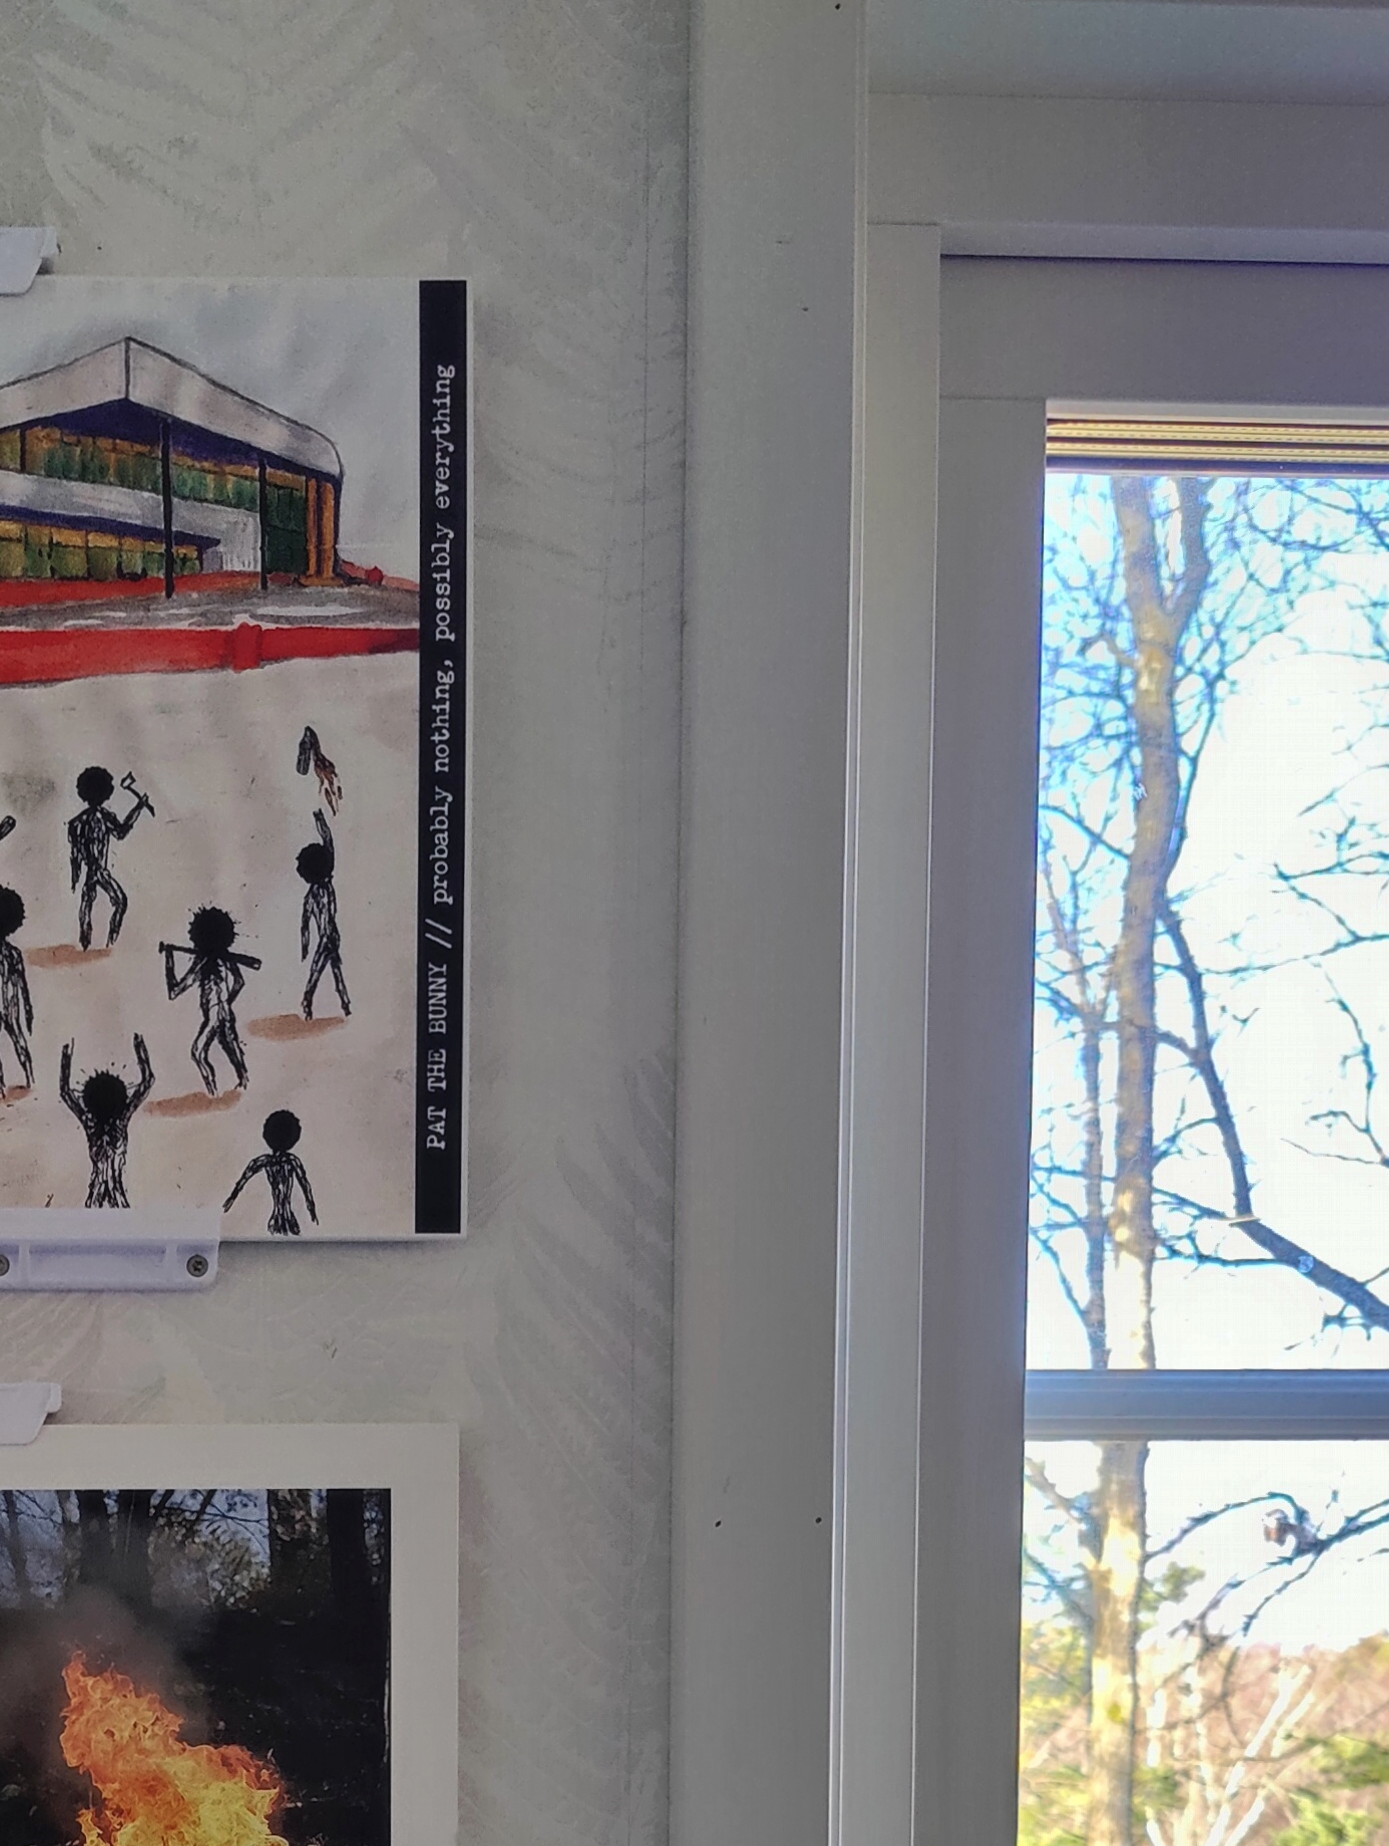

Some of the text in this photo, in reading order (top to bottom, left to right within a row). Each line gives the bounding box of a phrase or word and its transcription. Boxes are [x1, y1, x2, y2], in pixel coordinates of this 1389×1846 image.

[425, 364, 456, 1150] PAT THE BUNNY // probably nothing, possibly everything
